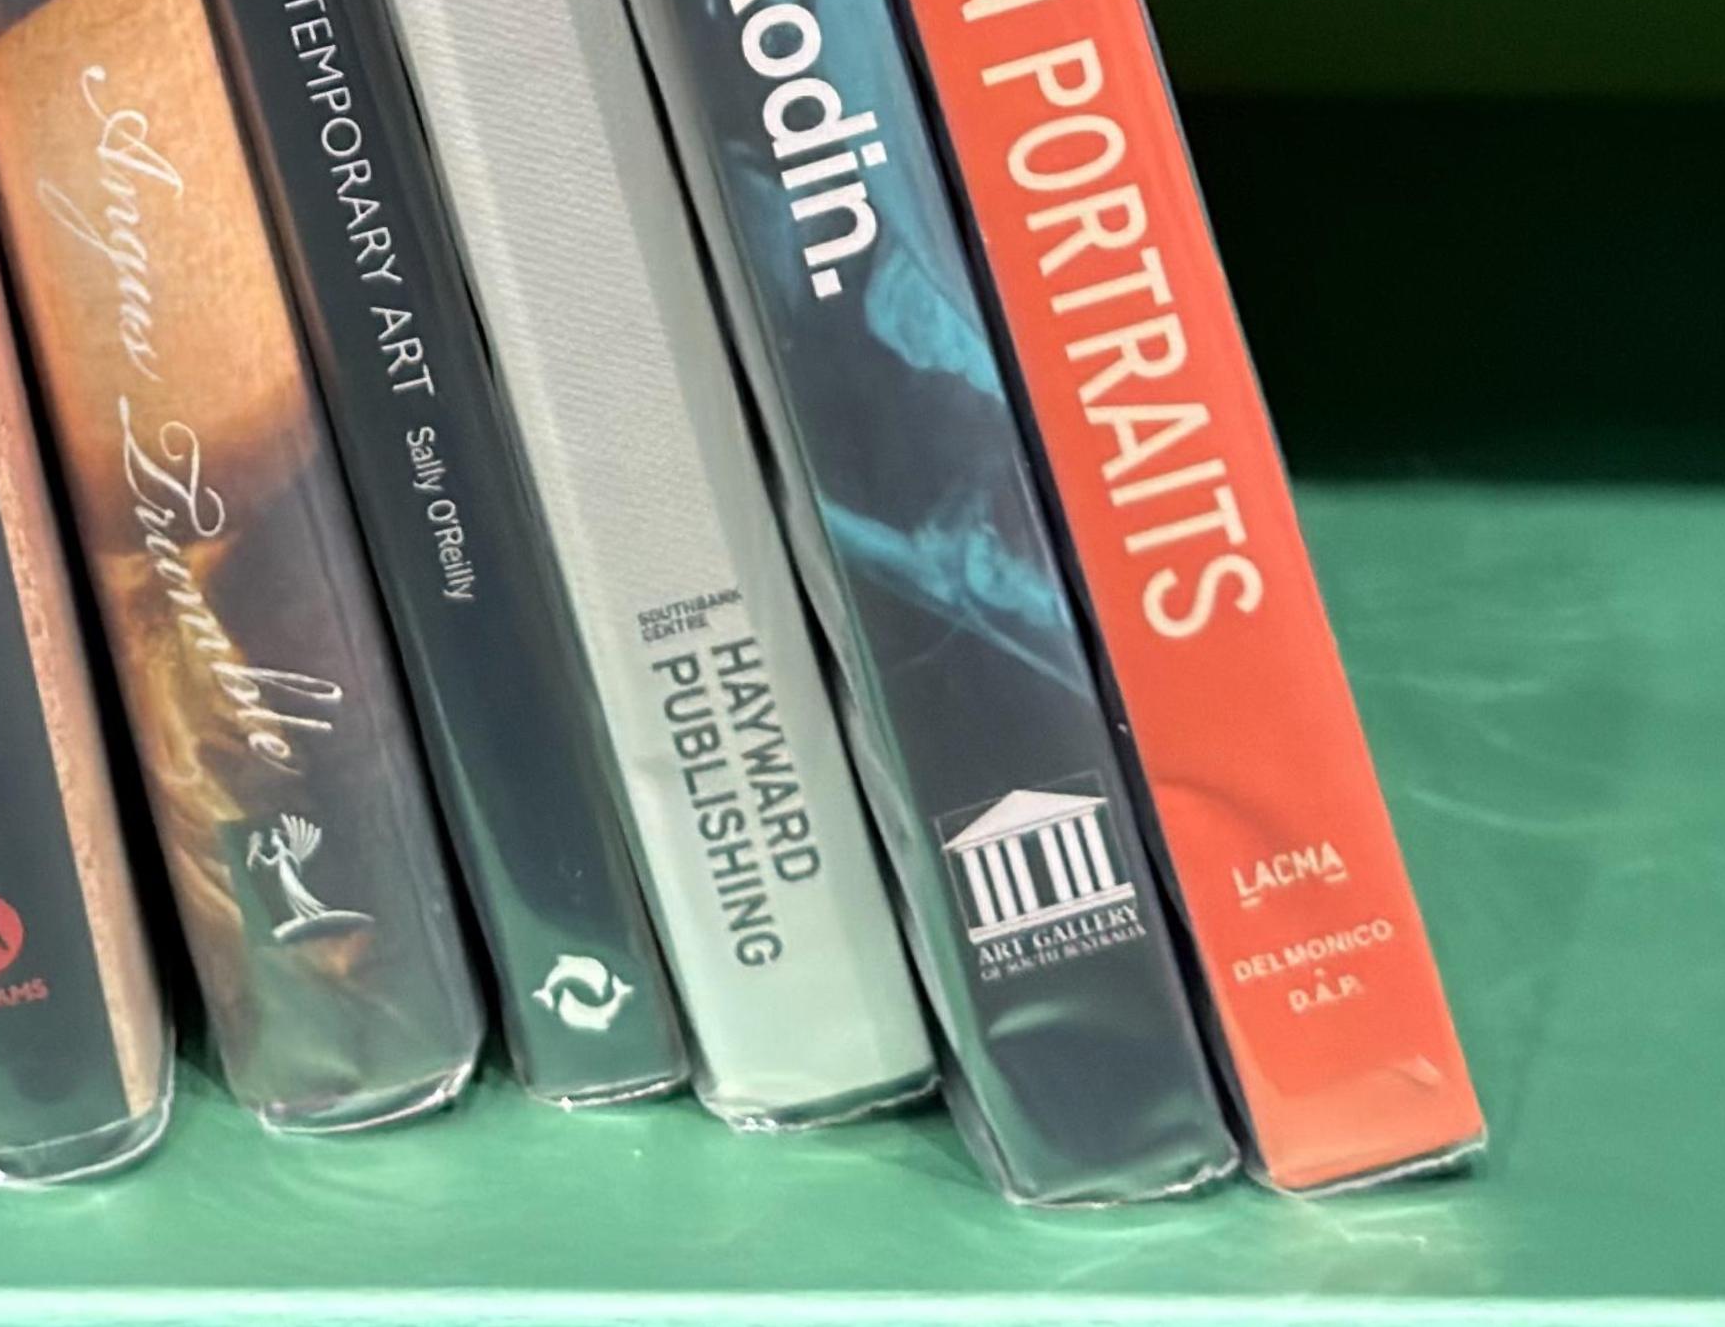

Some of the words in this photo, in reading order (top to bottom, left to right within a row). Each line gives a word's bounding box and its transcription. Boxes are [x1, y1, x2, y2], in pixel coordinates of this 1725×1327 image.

[371, 300, 437, 402] ART
[404, 424, 443, 496] Sally
[980, 37, 1265, 640] PORTRAITS
[38, 64, 184, 382] Angus
[118, 395, 344, 777] Trumble
[637, 587, 744, 627] SOUTHBANK
[641, 611, 712, 643] CENTRE
[651, 650, 783, 968] PUBLISHING
[710, 636, 823, 885] HAYWARD
[976, 935, 1027, 967] ART
[1031, 903, 1140, 950] GALLERY
[1231, 840, 1349, 909] LACMA
[1231, 918, 1395, 984] DELMONICO
